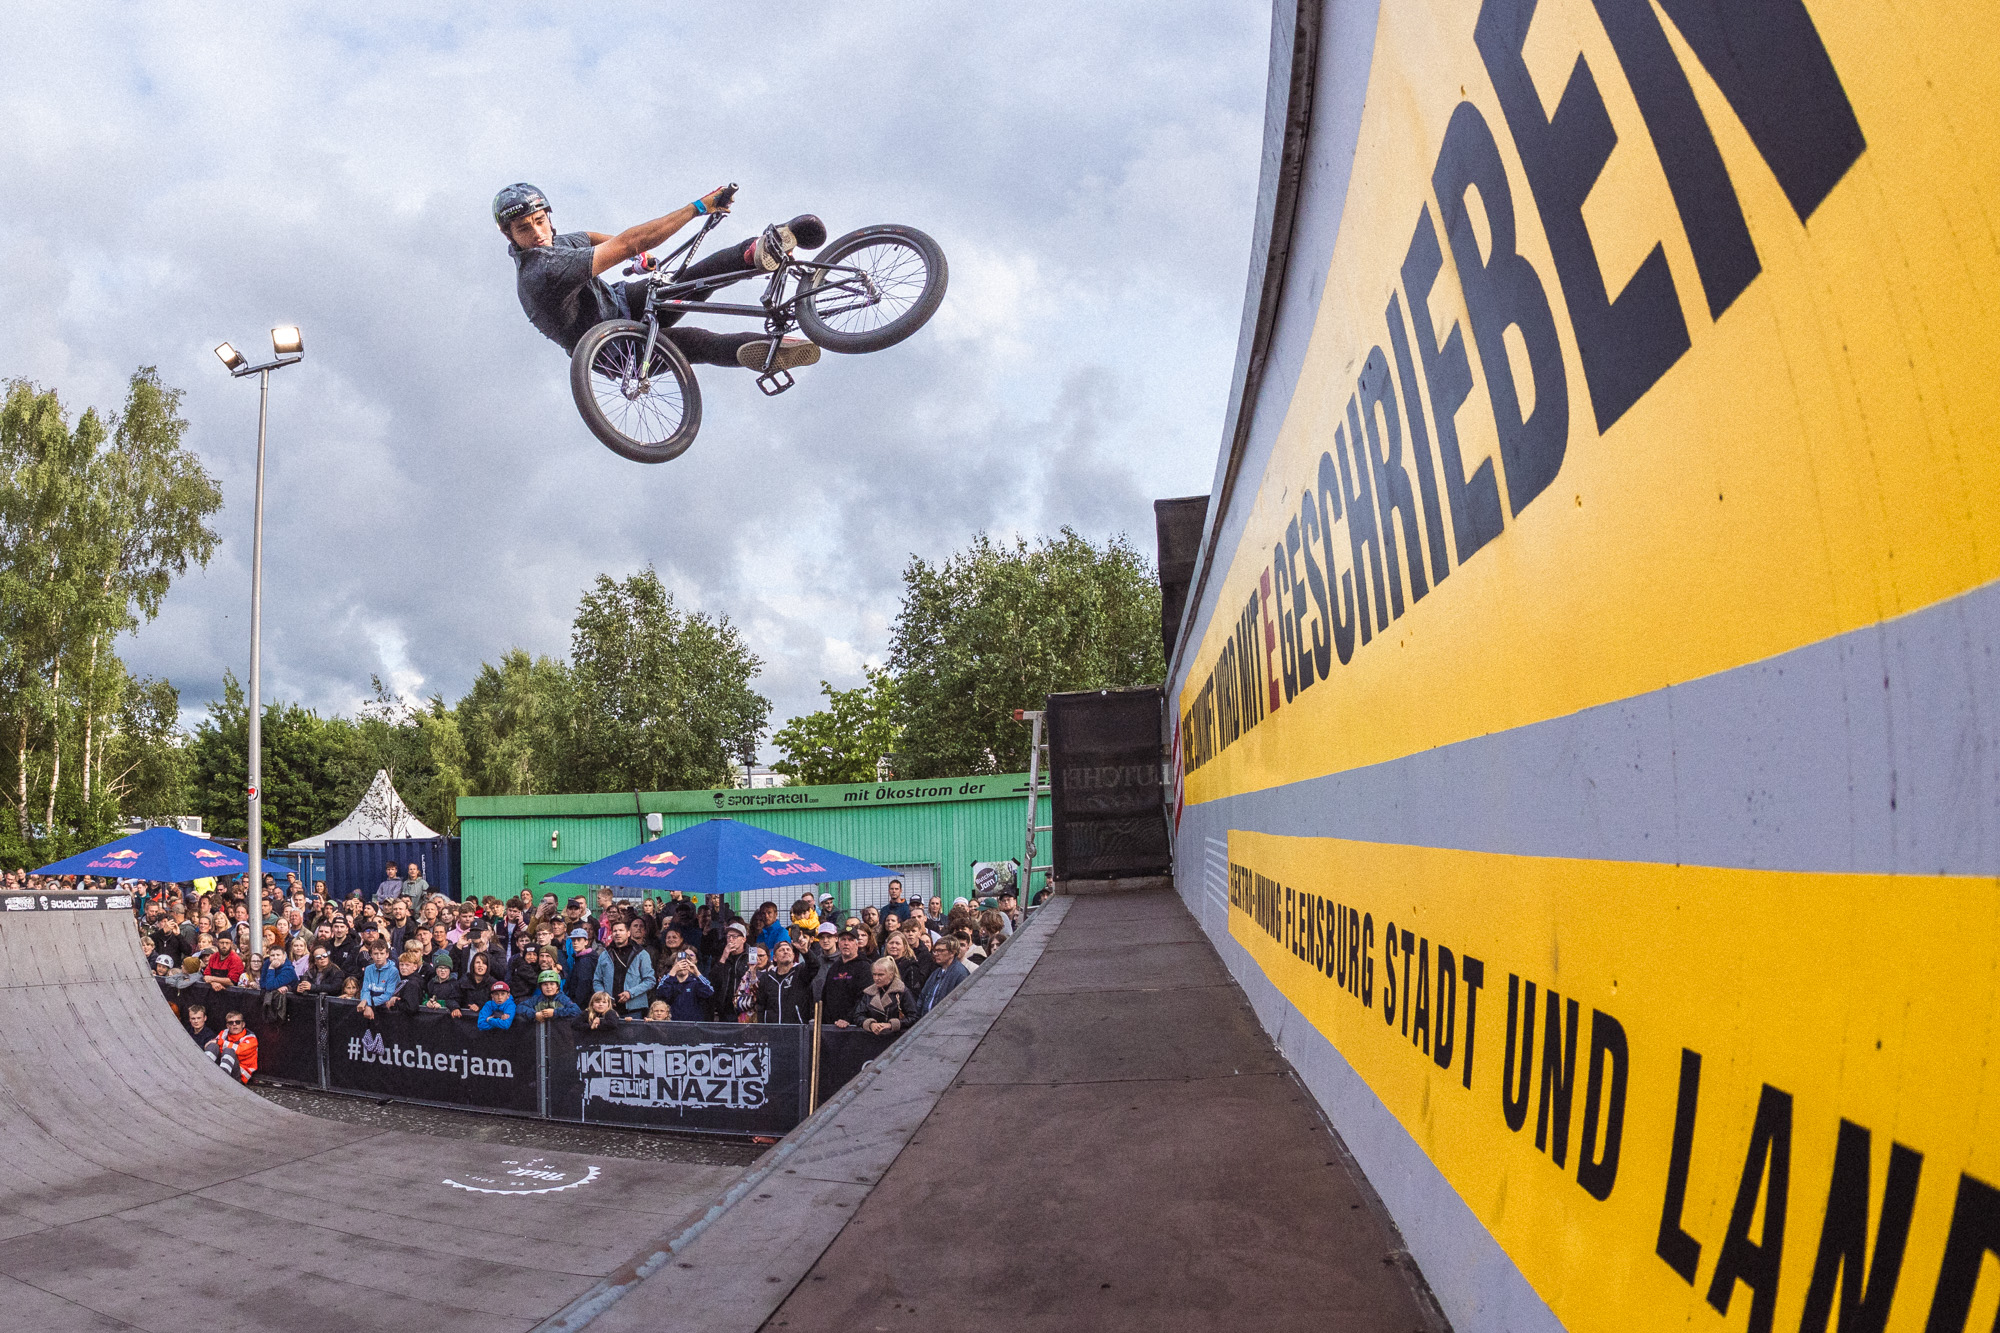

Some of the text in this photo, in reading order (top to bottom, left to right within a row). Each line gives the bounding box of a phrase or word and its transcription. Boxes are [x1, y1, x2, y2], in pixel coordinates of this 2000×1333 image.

[1236, 587, 1265, 735] MIT
[1260, 565, 1281, 714] E
[844, 789, 870, 803] mit
[875, 785, 953, 801] Ökostrom
[959, 782, 986, 796] der
[613, 866, 675, 878] Red Bull
[763, 862, 827, 876] Red Bull
[1286, 886, 1375, 1009] FLENSBURG
[1383, 921, 1485, 1092] STADT
[1502, 972, 1630, 1203] UND
[580, 1049, 760, 1077] KEIN BOCK
[609, 1076, 766, 1106] auf NAZIS
